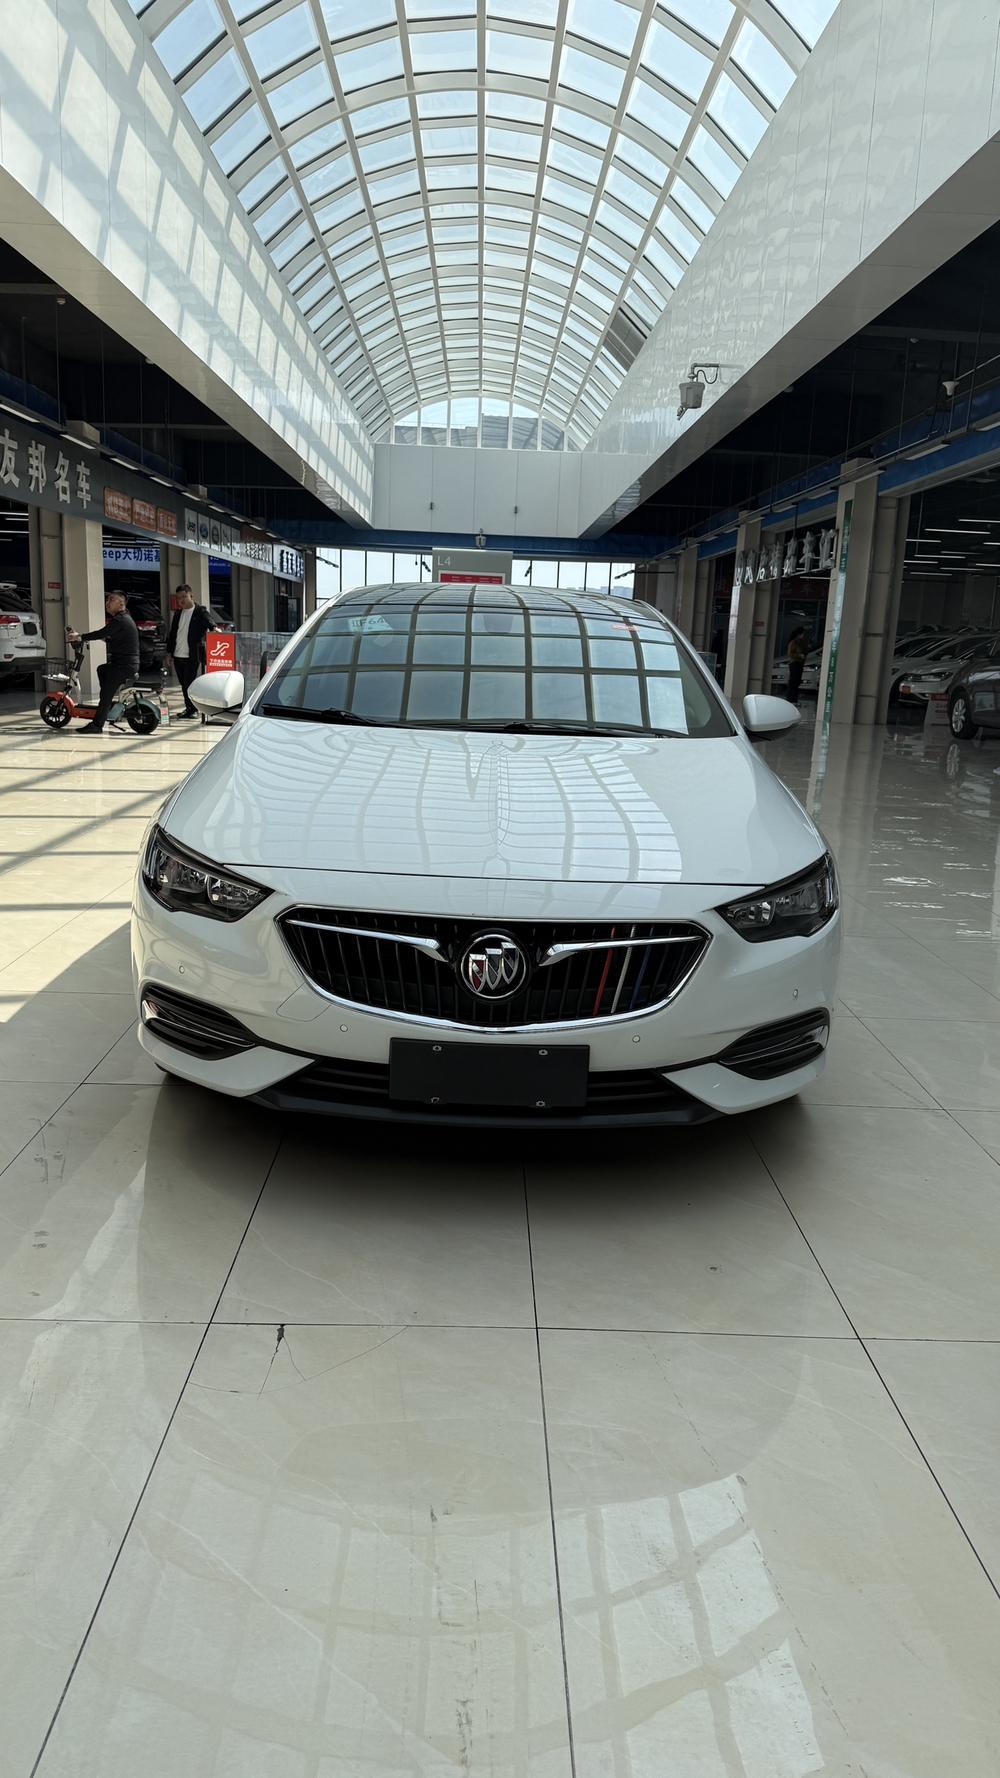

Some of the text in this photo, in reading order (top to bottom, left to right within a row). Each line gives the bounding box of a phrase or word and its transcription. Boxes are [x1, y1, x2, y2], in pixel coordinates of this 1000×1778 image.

[0, 428, 92, 509] 友邦名车
[438, 555, 450, 567] L4
